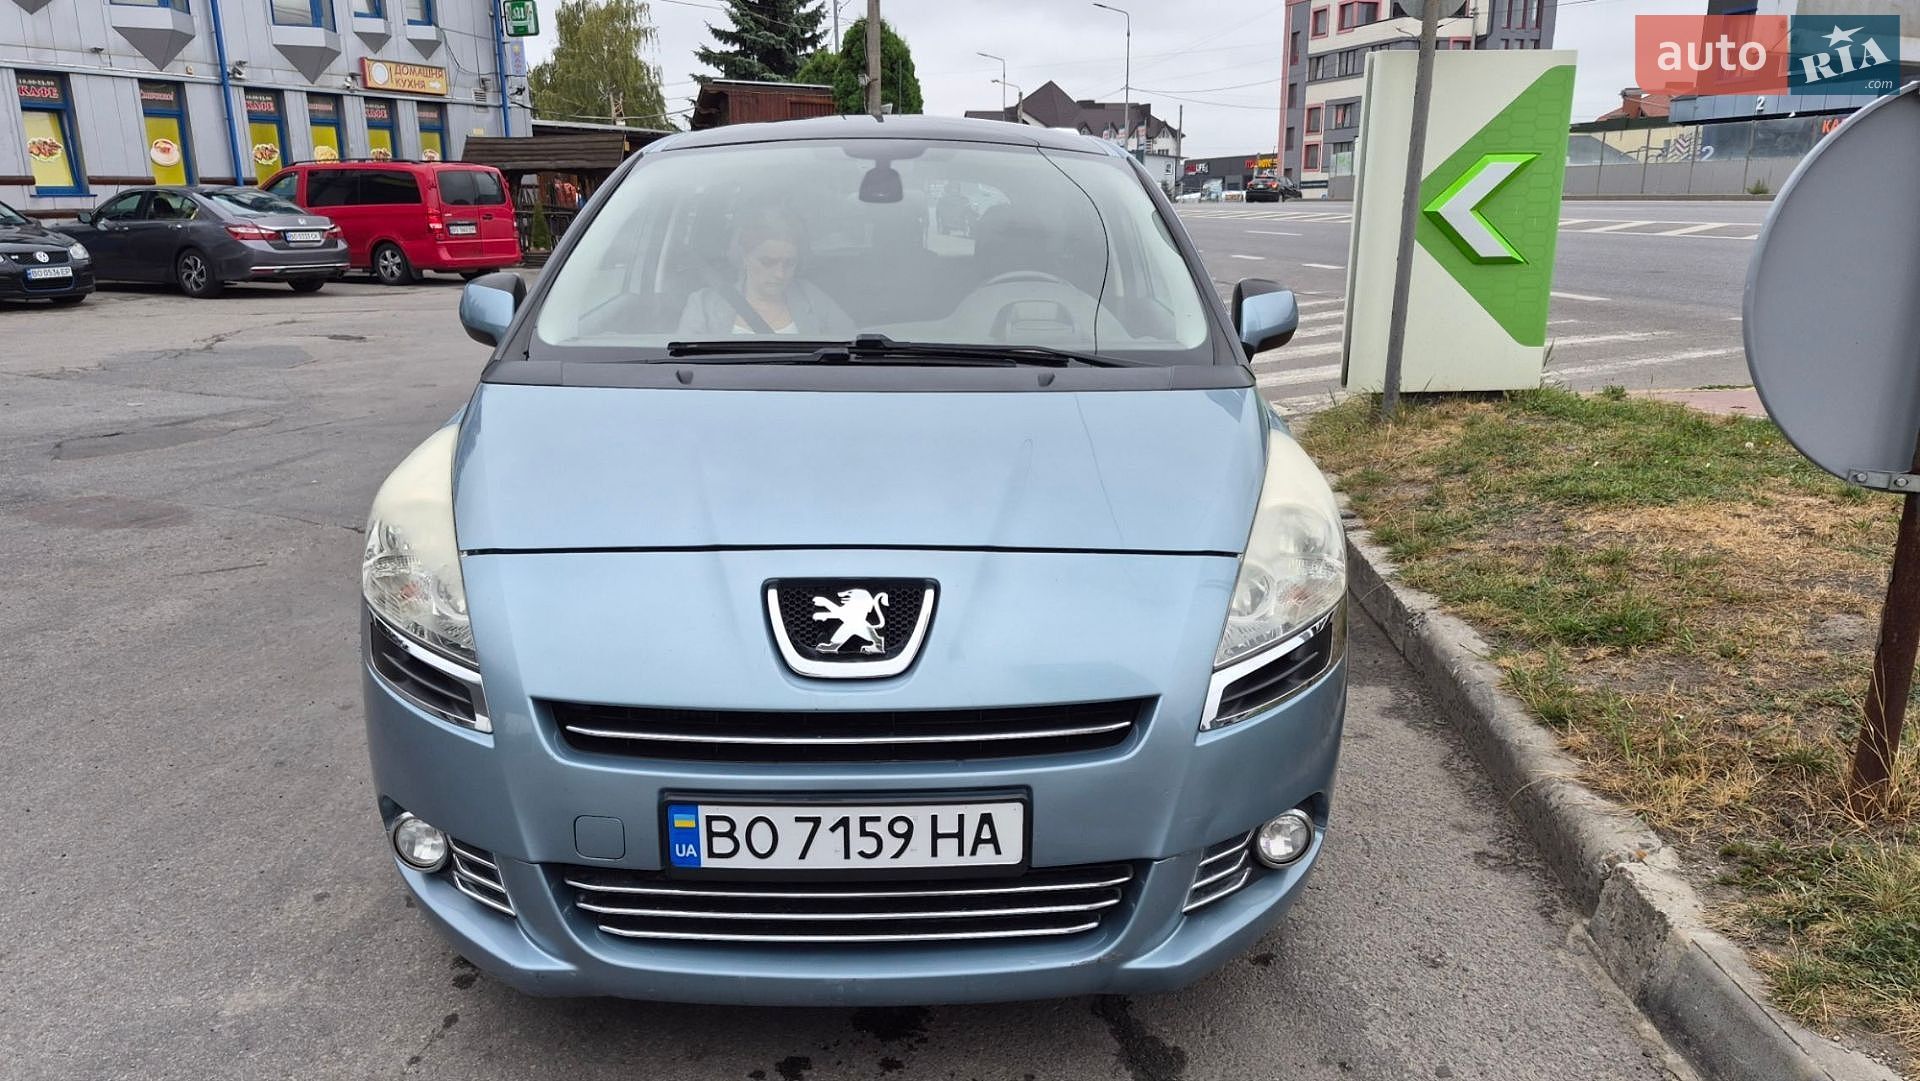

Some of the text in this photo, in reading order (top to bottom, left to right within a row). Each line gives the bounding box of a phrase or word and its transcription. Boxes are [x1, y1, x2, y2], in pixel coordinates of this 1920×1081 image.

[395, 64, 443, 79] ДОМАШНЯ
[395, 79, 426, 89] КУХНЯ
[17, 85, 60, 99] КАФЕ
[1756, 96, 1765, 112] 2
[705, 812, 1002, 861] BO 7159 HA
[675, 844, 697, 858] UA
